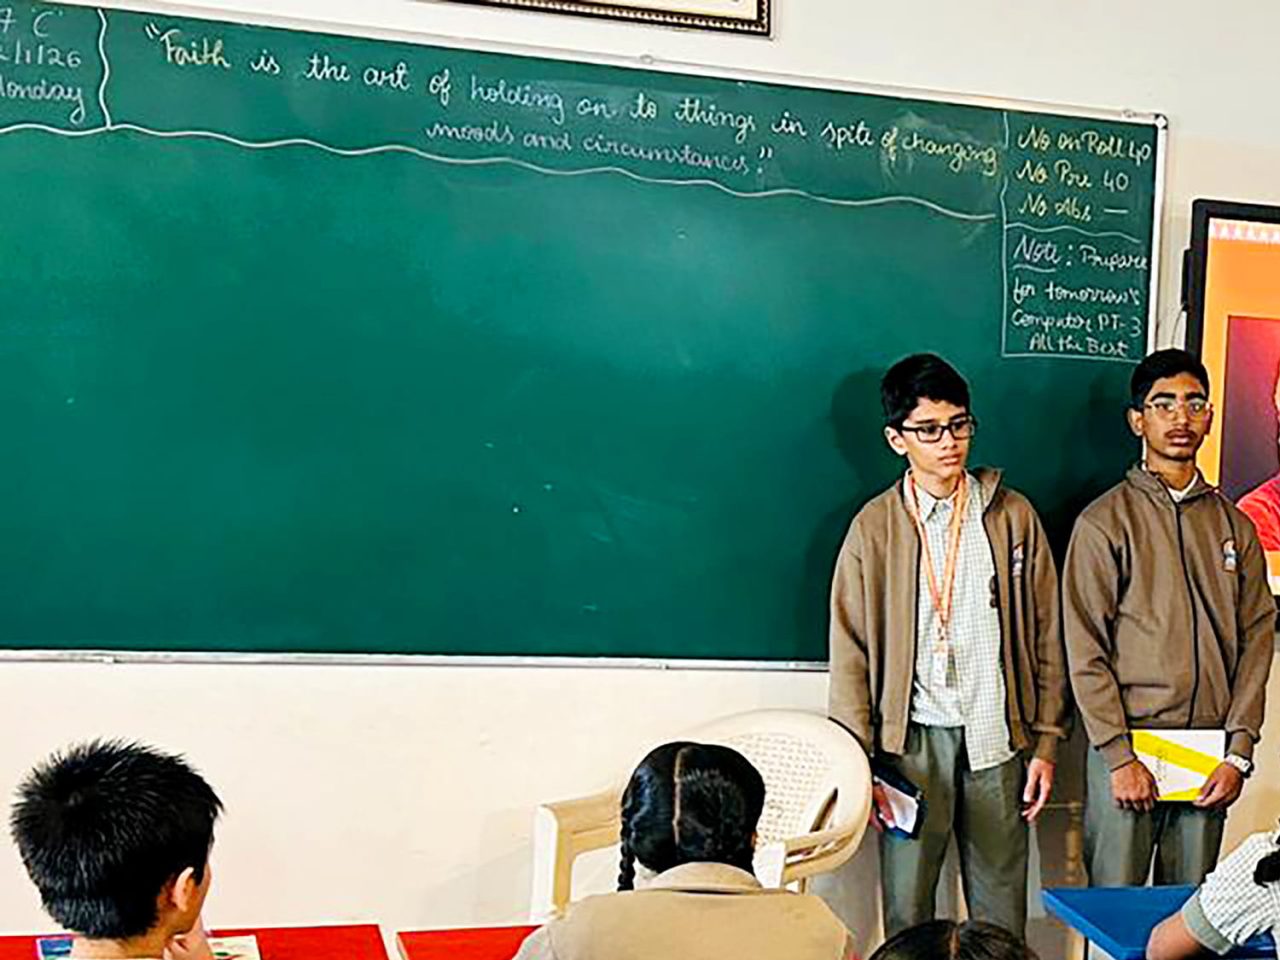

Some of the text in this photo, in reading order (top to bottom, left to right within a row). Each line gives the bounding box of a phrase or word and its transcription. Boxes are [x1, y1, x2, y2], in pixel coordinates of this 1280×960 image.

[250, 49, 281, 74] is
[304, 52, 350, 82] the
[363, 61, 411, 91] art
[429, 69, 451, 105] of
[471, 74, 565, 124] holding
[576, 98, 617, 119] on
[630, 92, 657, 119] to
[675, 97, 756, 144] things
[771, 111, 808, 137] in
[820, 120, 876, 150] spite
[881, 127, 899, 161] of
[902, 132, 997, 177] changing
[426, 120, 515, 146] moods
[523, 132, 572, 151] and
[1017, 124, 1051, 150] No
[1081, 130, 1126, 158] Roll
[1128, 140, 1152, 167] 40
[1016, 158, 1049, 184] No
[1103, 169, 1130, 193] 40
[1018, 192, 1049, 217] No
[1079, 243, 1148, 273] Prepare
[1013, 276, 1036, 305] for
[1029, 332, 1130, 357] All the Best
